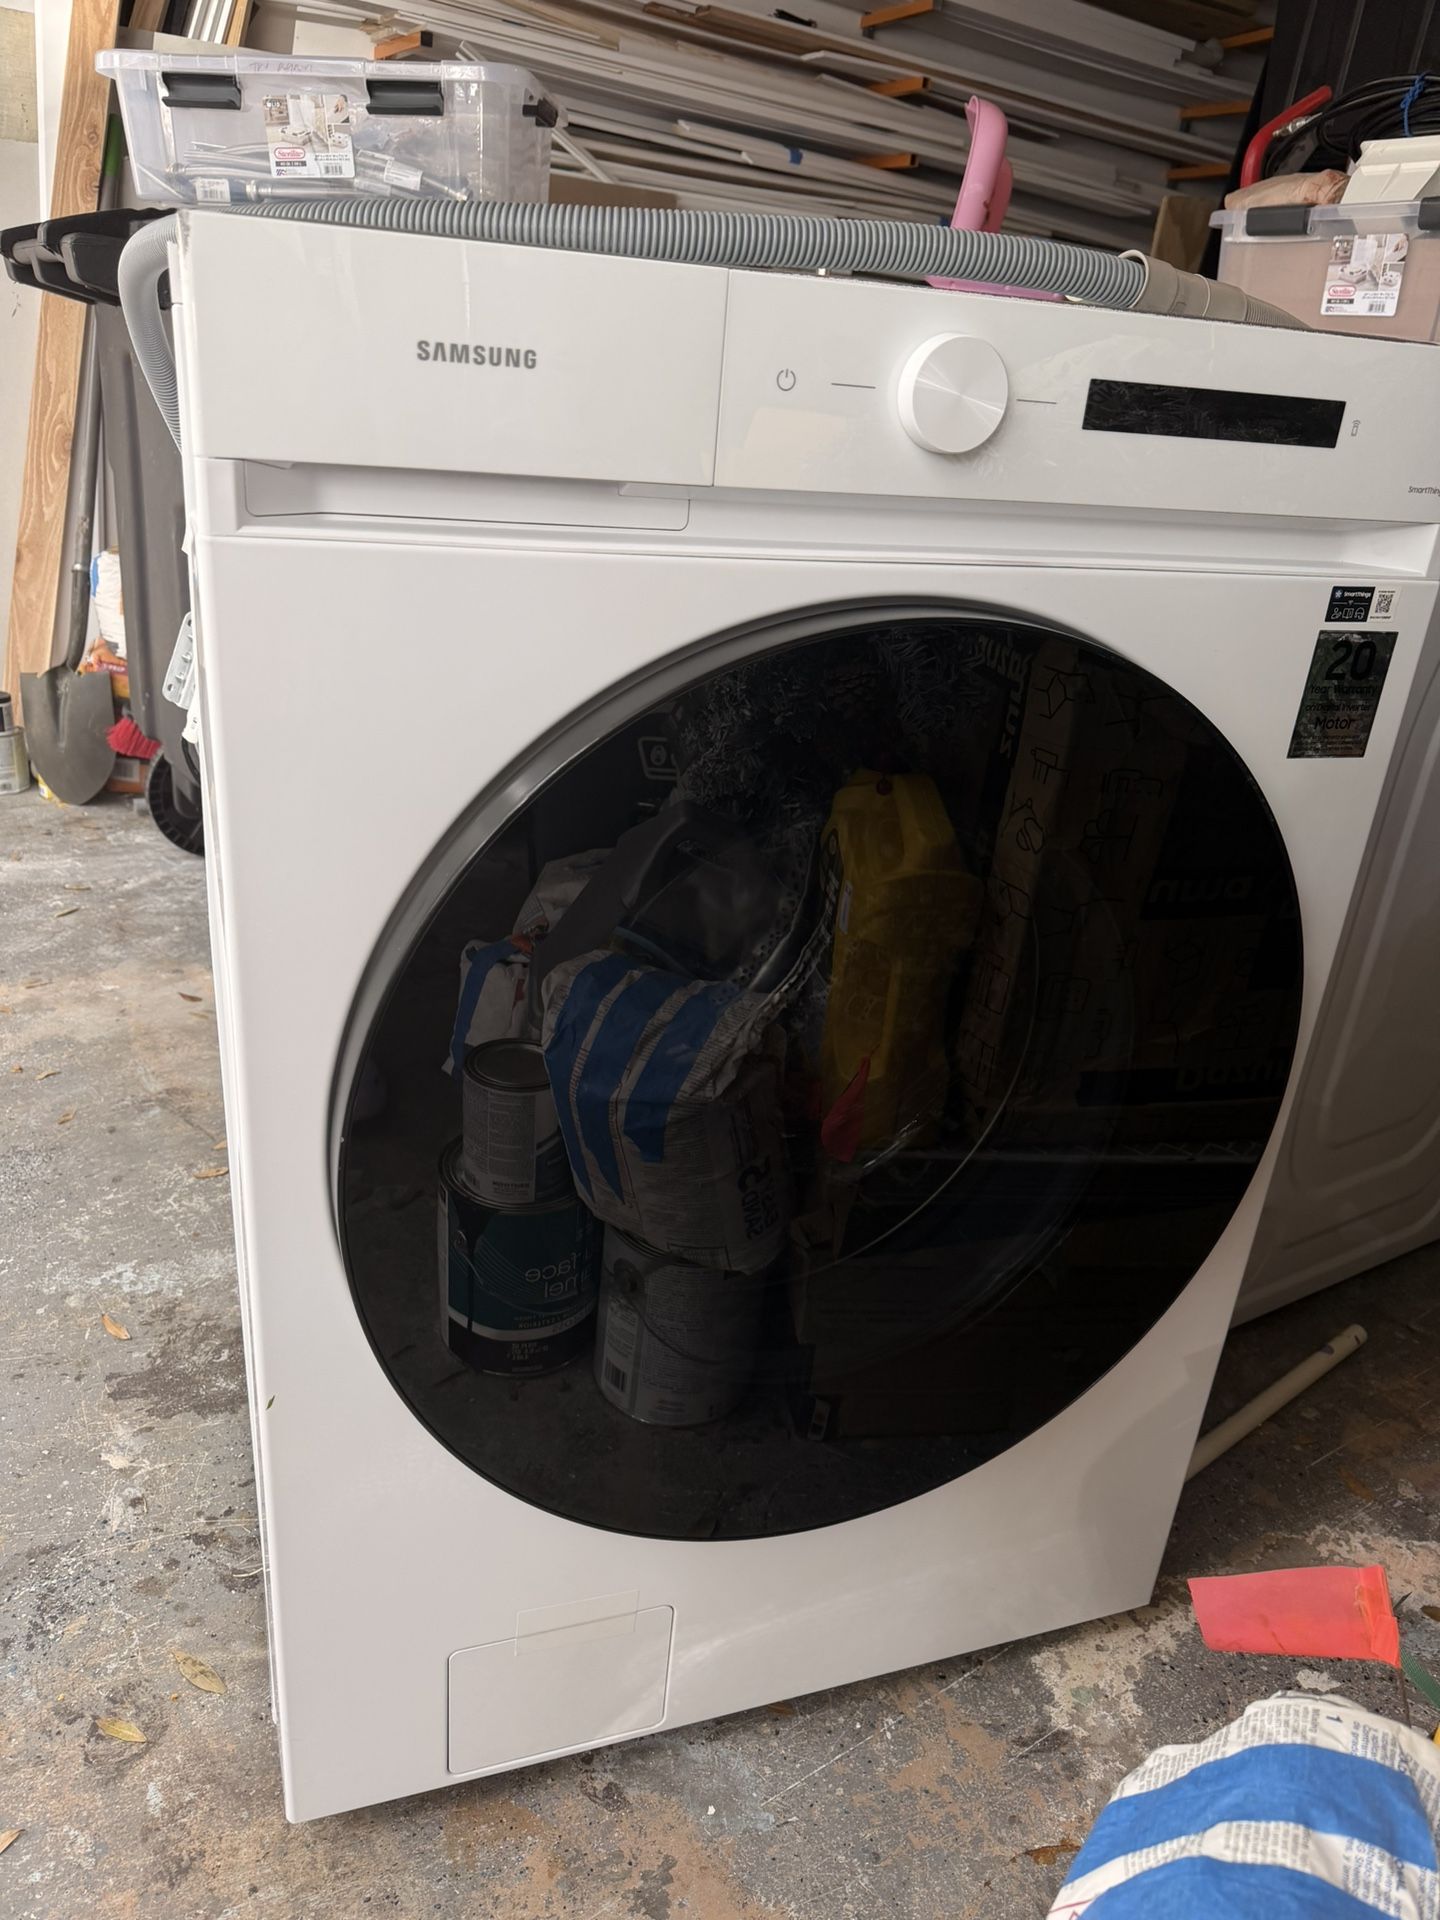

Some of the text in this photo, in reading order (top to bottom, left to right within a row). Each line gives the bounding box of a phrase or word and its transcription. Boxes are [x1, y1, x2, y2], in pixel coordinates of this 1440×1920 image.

[416, 340, 538, 370] SAMSUNG
[1325, 640, 1377, 681] 20
[1313, 716, 1356, 730] Motor
